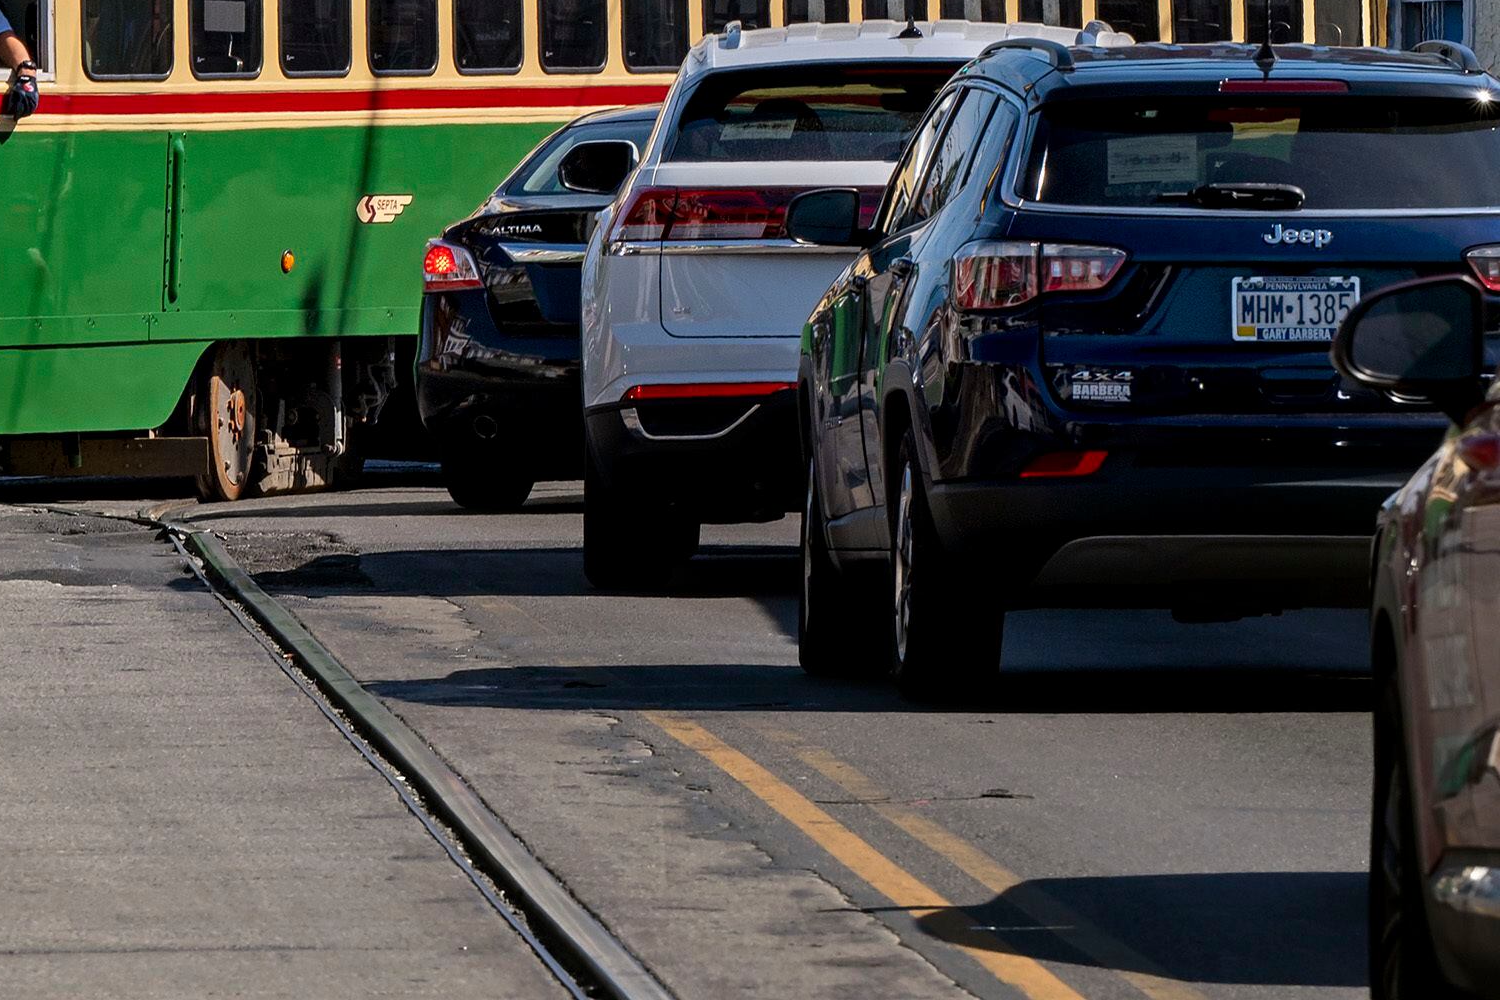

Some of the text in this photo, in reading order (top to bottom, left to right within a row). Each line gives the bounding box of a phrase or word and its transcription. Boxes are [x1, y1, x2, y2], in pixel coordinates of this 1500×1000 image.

[376, 199, 398, 211] SEPTA
[492, 224, 542, 235] ALTIMA
[1263, 223, 1332, 248] Jeep
[1266, 282, 1328, 290] PENNSYLVANIA
[1262, 328, 1331, 340] GARY BARBERA
[1072, 384, 1131, 396] BARBERA
